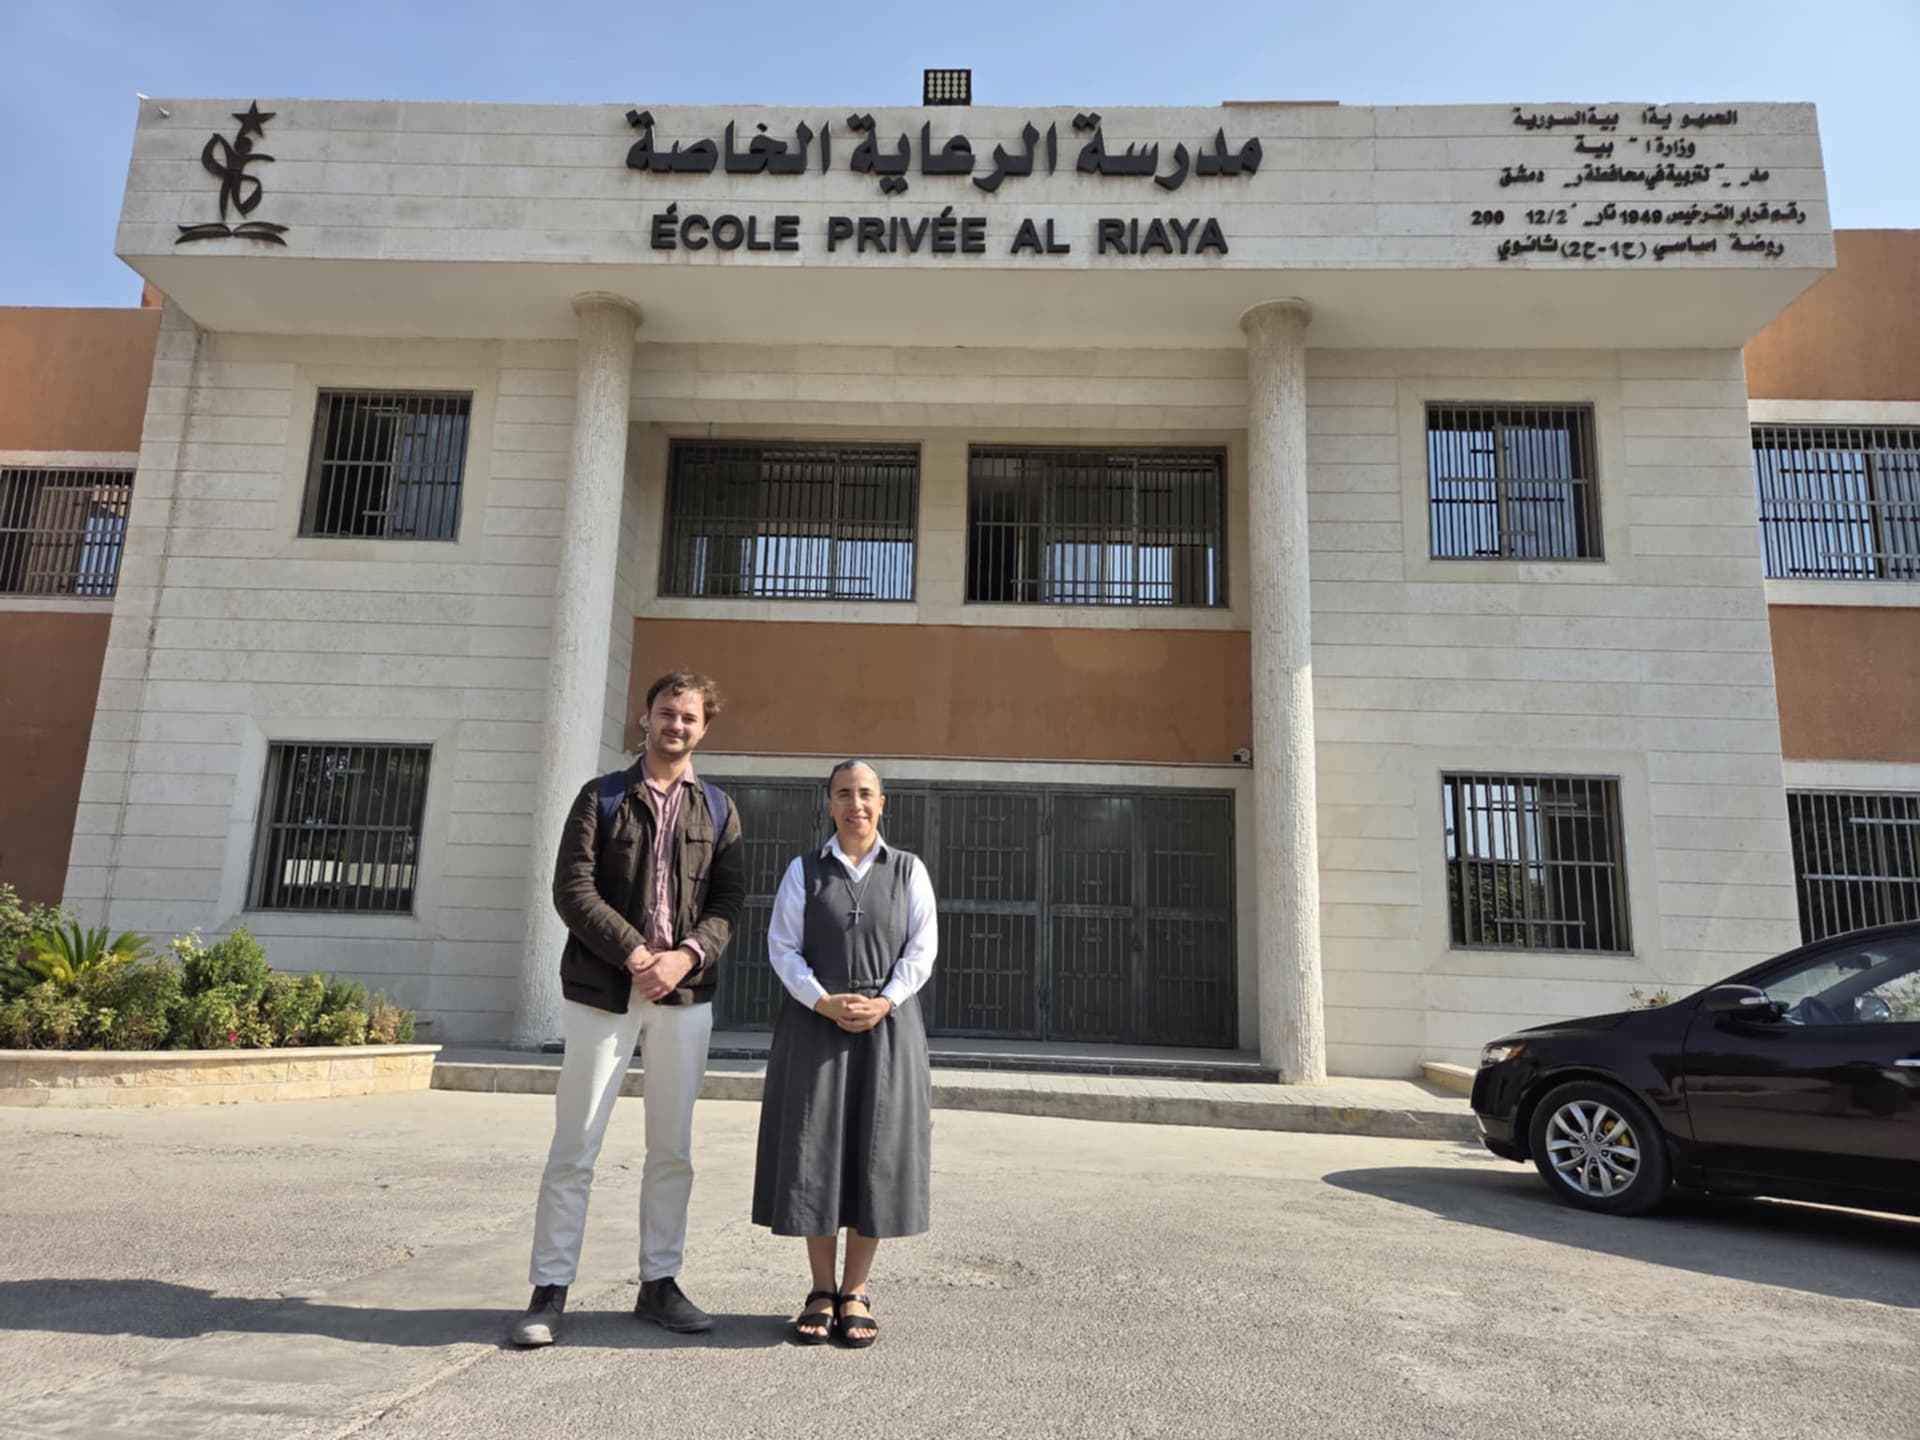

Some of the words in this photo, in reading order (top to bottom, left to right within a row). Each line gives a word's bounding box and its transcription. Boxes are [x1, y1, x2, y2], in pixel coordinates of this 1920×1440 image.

[1513, 107, 1586, 130] السورية
[626, 110, 831, 176] الخاصة
[847, 114, 1057, 195] الرعاية
[1072, 113, 1262, 192] مدرسة
[1655, 136, 1695, 158] وزارة
[1500, 164, 1544, 187] دمشق
[1735, 202, 1770, 226] قرار
[1770, 202, 1806, 224] رقم
[651, 202, 800, 251] ÉCOLE
[827, 206, 986, 254] PRIVÉE
[1011, 219, 1070, 254] AL
[1098, 218, 1228, 255] RIAYA
[1498, 234, 1558, 261] ثانوي
[1728, 233, 1784, 258] روضة
